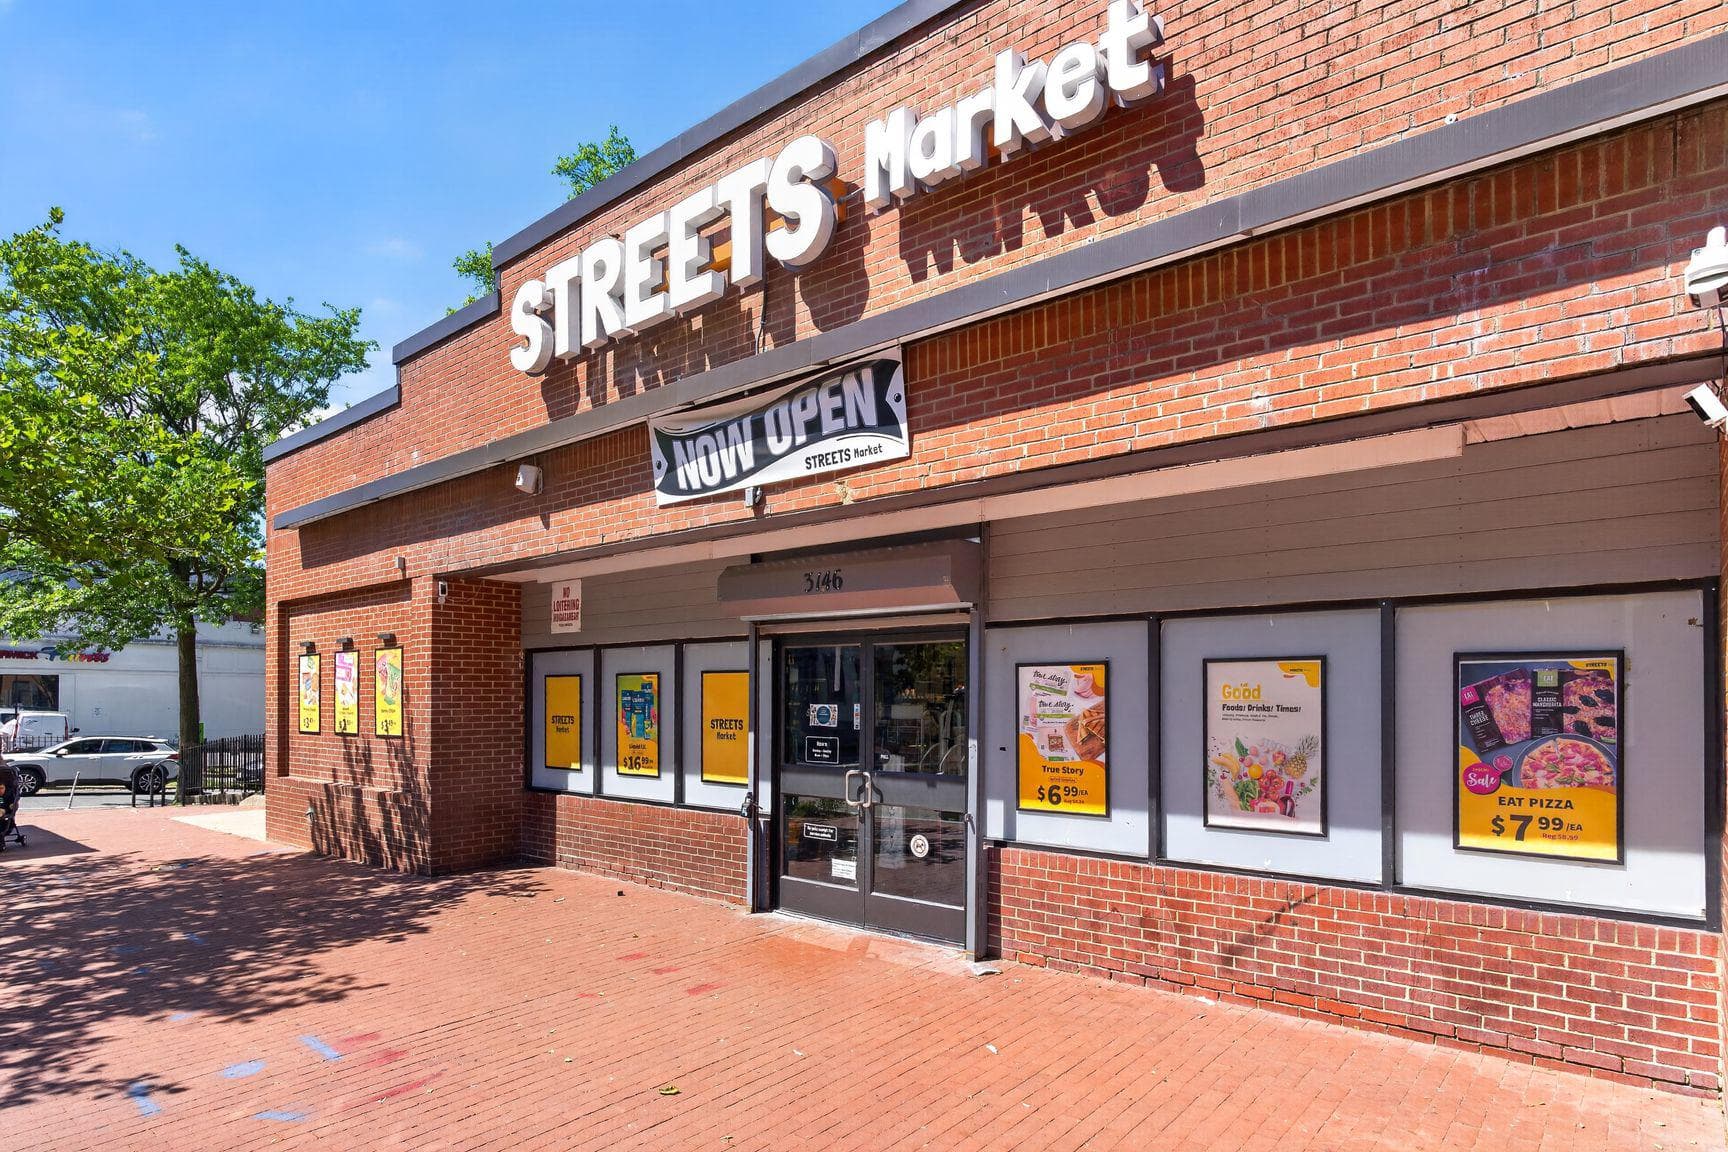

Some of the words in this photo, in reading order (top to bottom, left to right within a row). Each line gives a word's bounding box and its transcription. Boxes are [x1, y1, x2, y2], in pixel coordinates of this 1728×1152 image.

[863, 0, 1163, 212] Market
[510, 134, 837, 376] STREETS
[672, 414, 755, 490] NOW
[764, 367, 878, 456] OPEN
[804, 448, 851, 470] STREETS
[853, 443, 883, 459] Market
[804, 569, 843, 593] 3146
[1222, 684, 1261, 700] Good
[1222, 703, 1246, 712] Foods!
[1247, 704, 1274, 713] Drinks!
[551, 715, 575, 725] STREETS
[710, 718, 744, 731] STREETS
[716, 731, 737, 741] Market
[1042, 765, 1060, 774] True
[1061, 766, 1084, 777] Story
[1466, 772, 1496, 788] Sale
[1498, 796, 1525, 808] EAT
[1529, 798, 1574, 810] PIZZA
